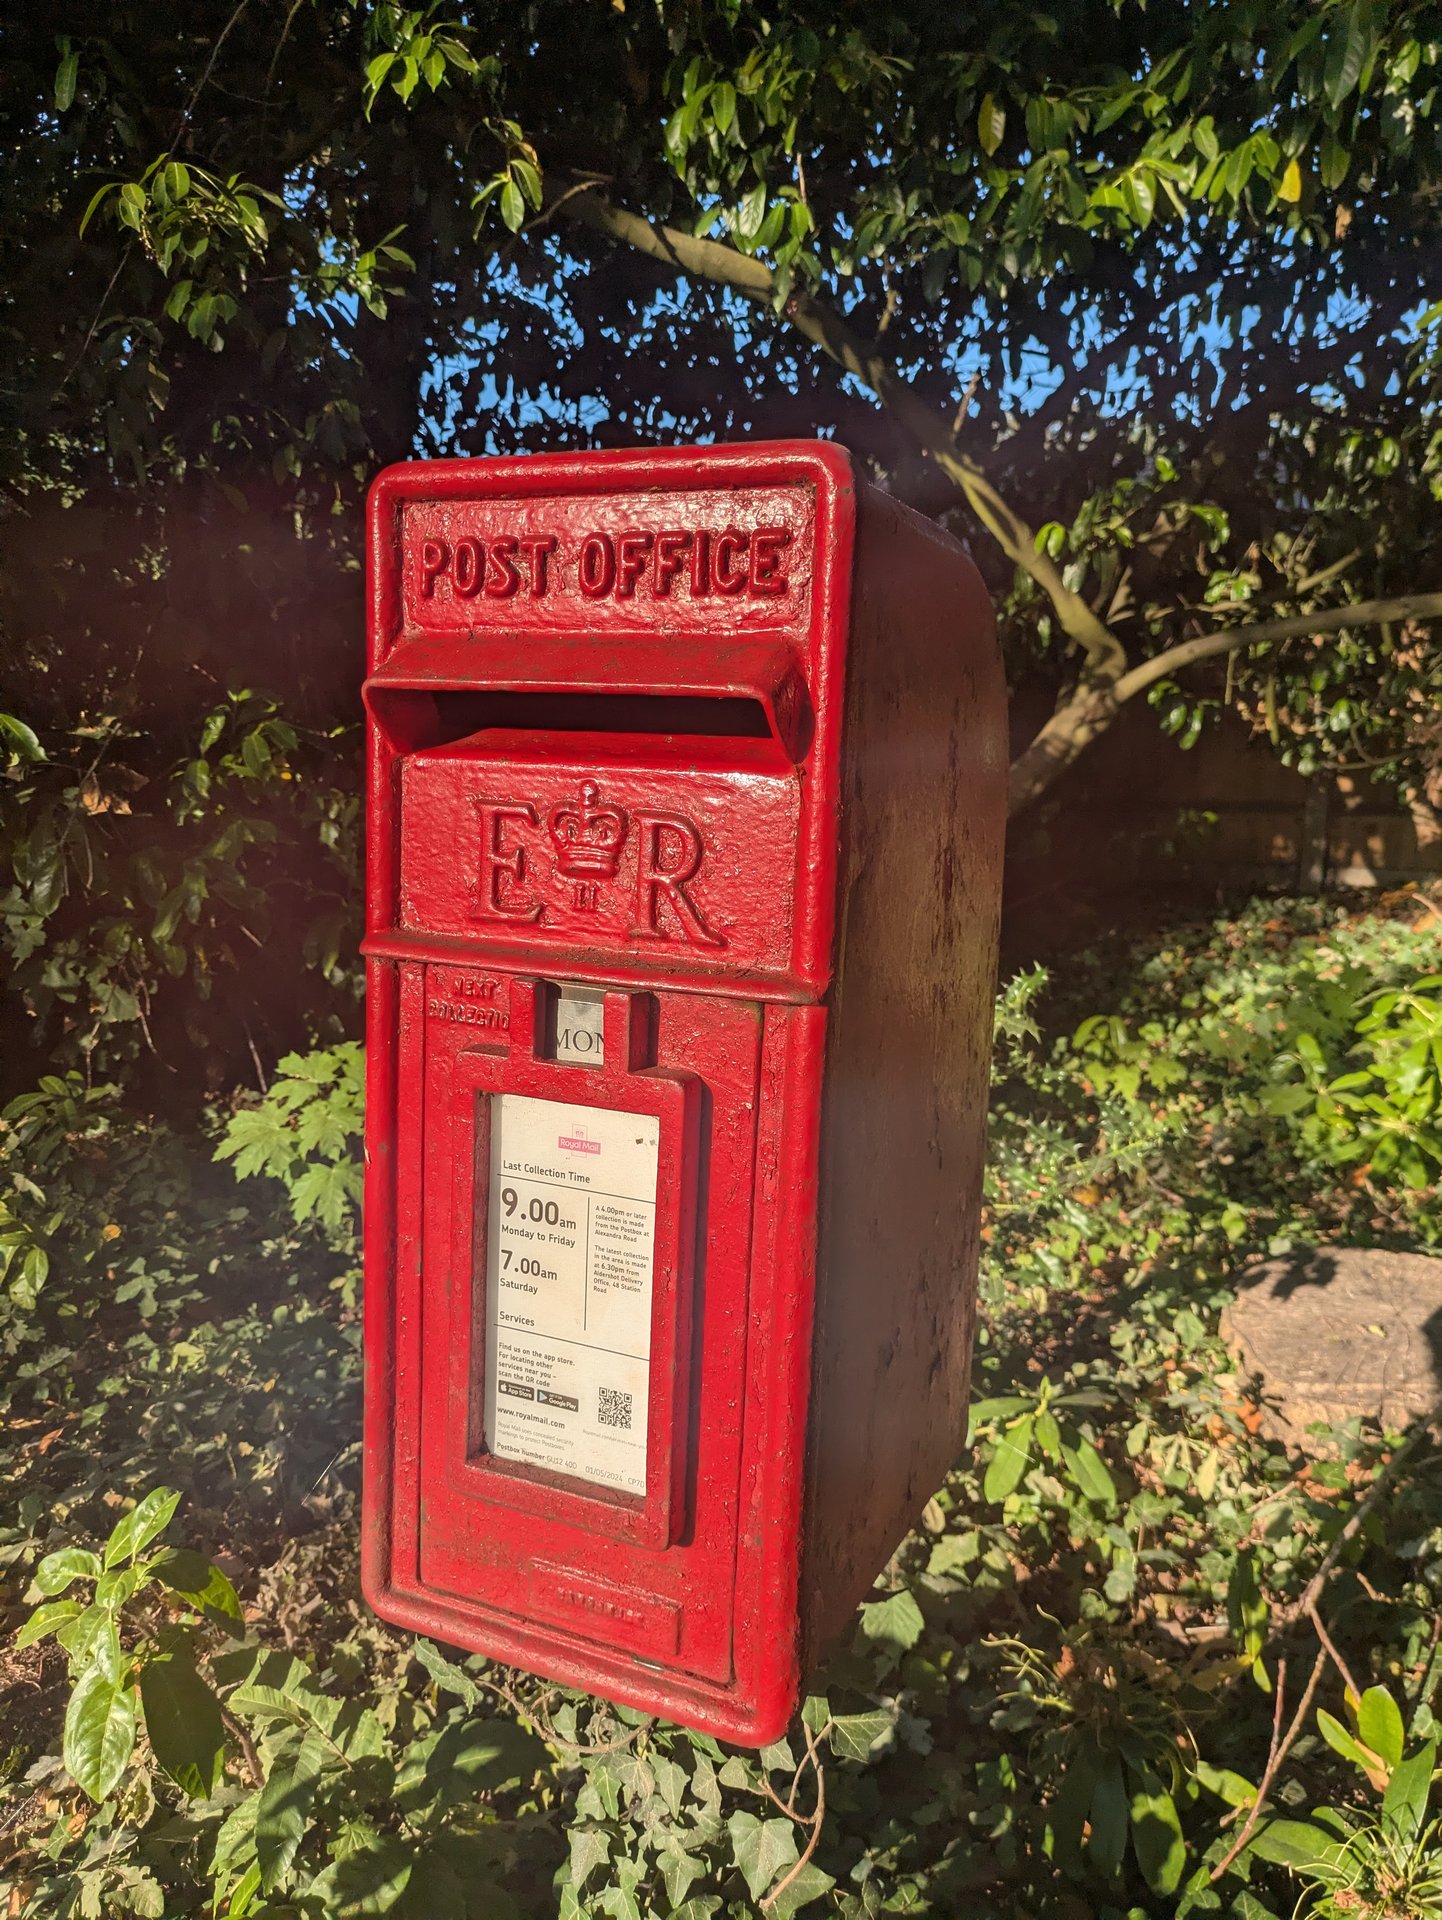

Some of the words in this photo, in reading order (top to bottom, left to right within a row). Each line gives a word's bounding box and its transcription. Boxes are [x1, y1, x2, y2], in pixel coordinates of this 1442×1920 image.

[420, 534, 557, 599] POST
[579, 527, 794, 597] OFFICE
[471, 800, 543, 923] E
[629, 808, 729, 949] R
[454, 975, 499, 998] NEXT
[429, 999, 511, 1031] COLLECTIO
[560, 1138, 580, 1150] Royal
[582, 1141, 599, 1152] Mail
[503, 1160, 522, 1171] Last
[524, 1163, 566, 1179] Collection
[568, 1171, 591, 1184] Time
[501, 1187, 577, 1230] 9.00am
[601, 1205, 625, 1216] 4.00pm
[634, 1212, 647, 1220] later
[595, 1214, 621, 1223] collection
[629, 1220, 644, 1228] made
[501, 1224, 534, 1241] Monday
[537, 1231, 546, 1241] to
[548, 1234, 576, 1248] Friday
[595, 1229, 622, 1240] Alexandra
[623, 1235, 637, 1243] Road
[621, 1226, 642, 1236] Postbox
[606, 1247, 622, 1256] latest
[623, 1252, 649, 1261] collection
[500, 1249, 558, 1281] 7.00am
[601, 1263, 625, 1274] 6.30pm
[626, 1269, 639, 1277] from
[631, 1261, 647, 1269] made
[500, 1278, 538, 1295] Saturday
[593, 1270, 620, 1281] Aldershot
[621, 1275, 643, 1286] Delivery
[593, 1285, 607, 1293] Road
[621, 1283, 641, 1293] Station
[499, 1311, 535, 1327] Services
[498, 1342, 512, 1351] Find
[532, 1350, 542, 1358] the
[544, 1353, 556, 1362] app
[557, 1356, 576, 1366] store.
[498, 1351, 509, 1359] For
[510, 1354, 535, 1366] locating
[536, 1360, 553, 1370] other
[498, 1361, 523, 1372] services
[540, 1371, 552, 1379] you
[498, 1370, 512, 1378] scan
[513, 1373, 524, 1381] the
[525, 1375, 535, 1383] QR
[536, 1379, 551, 1388] code
[508, 1388, 519, 1396] App
[519, 1390, 533, 1399] Store
[548, 1397, 566, 1407] Google
[566, 1401, 577, 1410] Play
[497, 1406, 566, 1429] www.royalmail.com
[497, 1442, 521, 1455] Postbox
[522, 1448, 546, 1461] number
[585, 1465, 624, 1482] 01/05/2024
